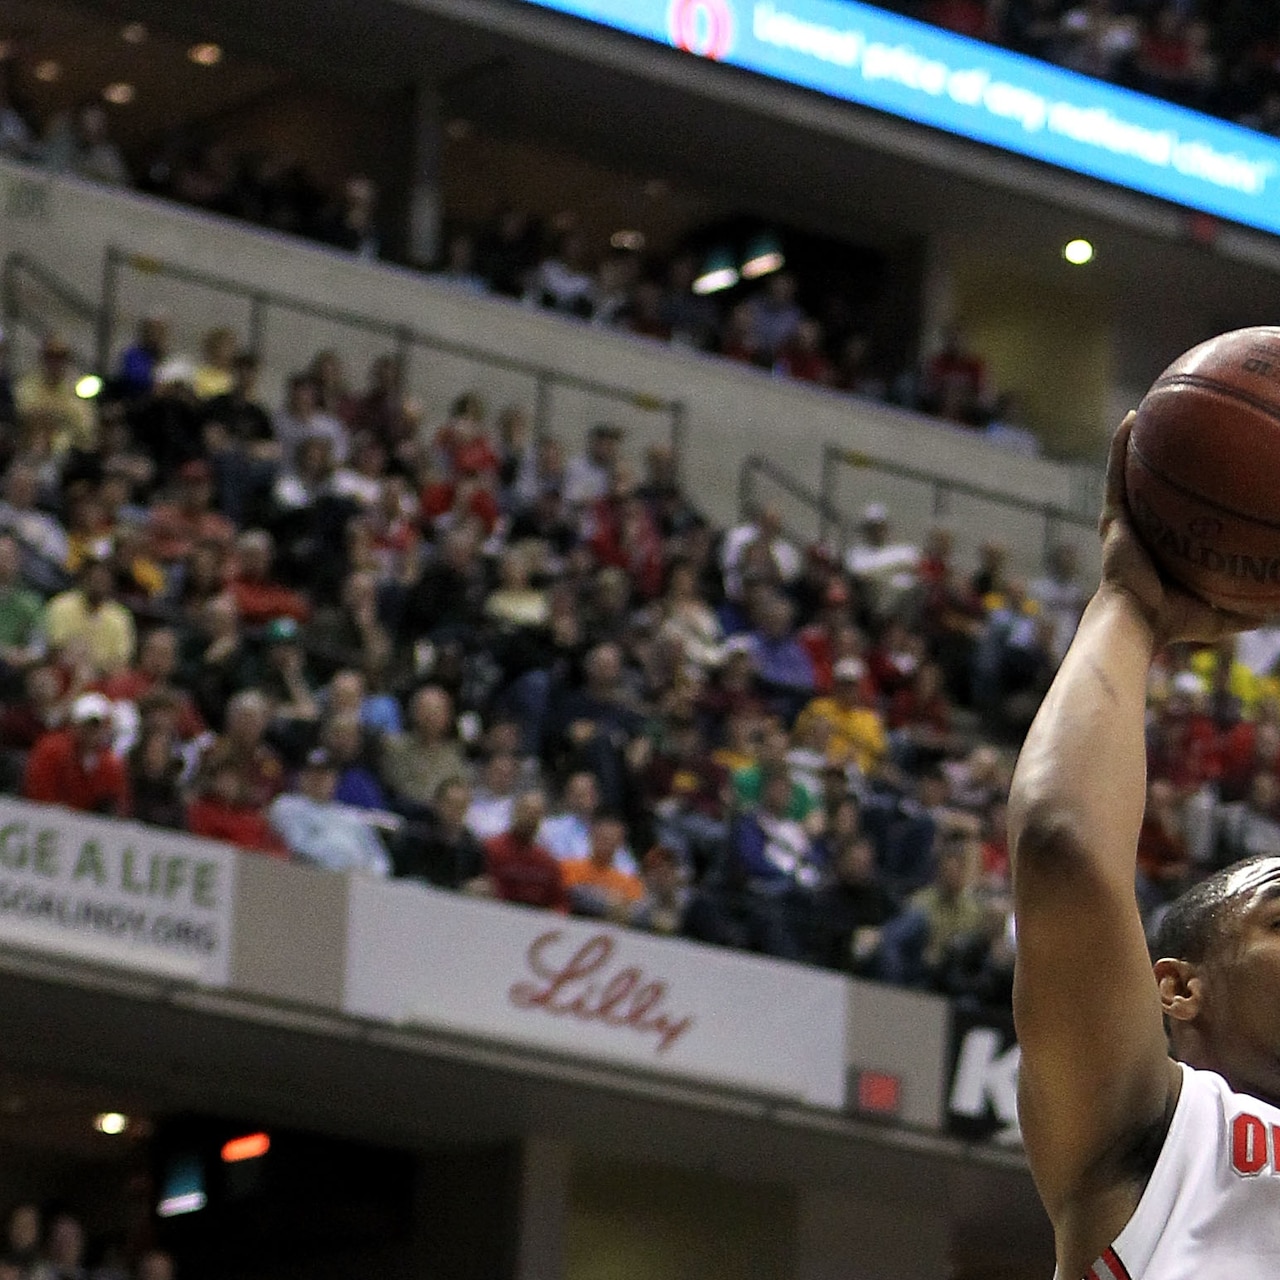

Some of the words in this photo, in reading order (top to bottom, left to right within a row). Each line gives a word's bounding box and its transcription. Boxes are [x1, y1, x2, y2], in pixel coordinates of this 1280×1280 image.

[73, 838, 107, 885] A
[121, 846, 219, 908] LIFE
[508, 928, 693, 1054] Lilly
